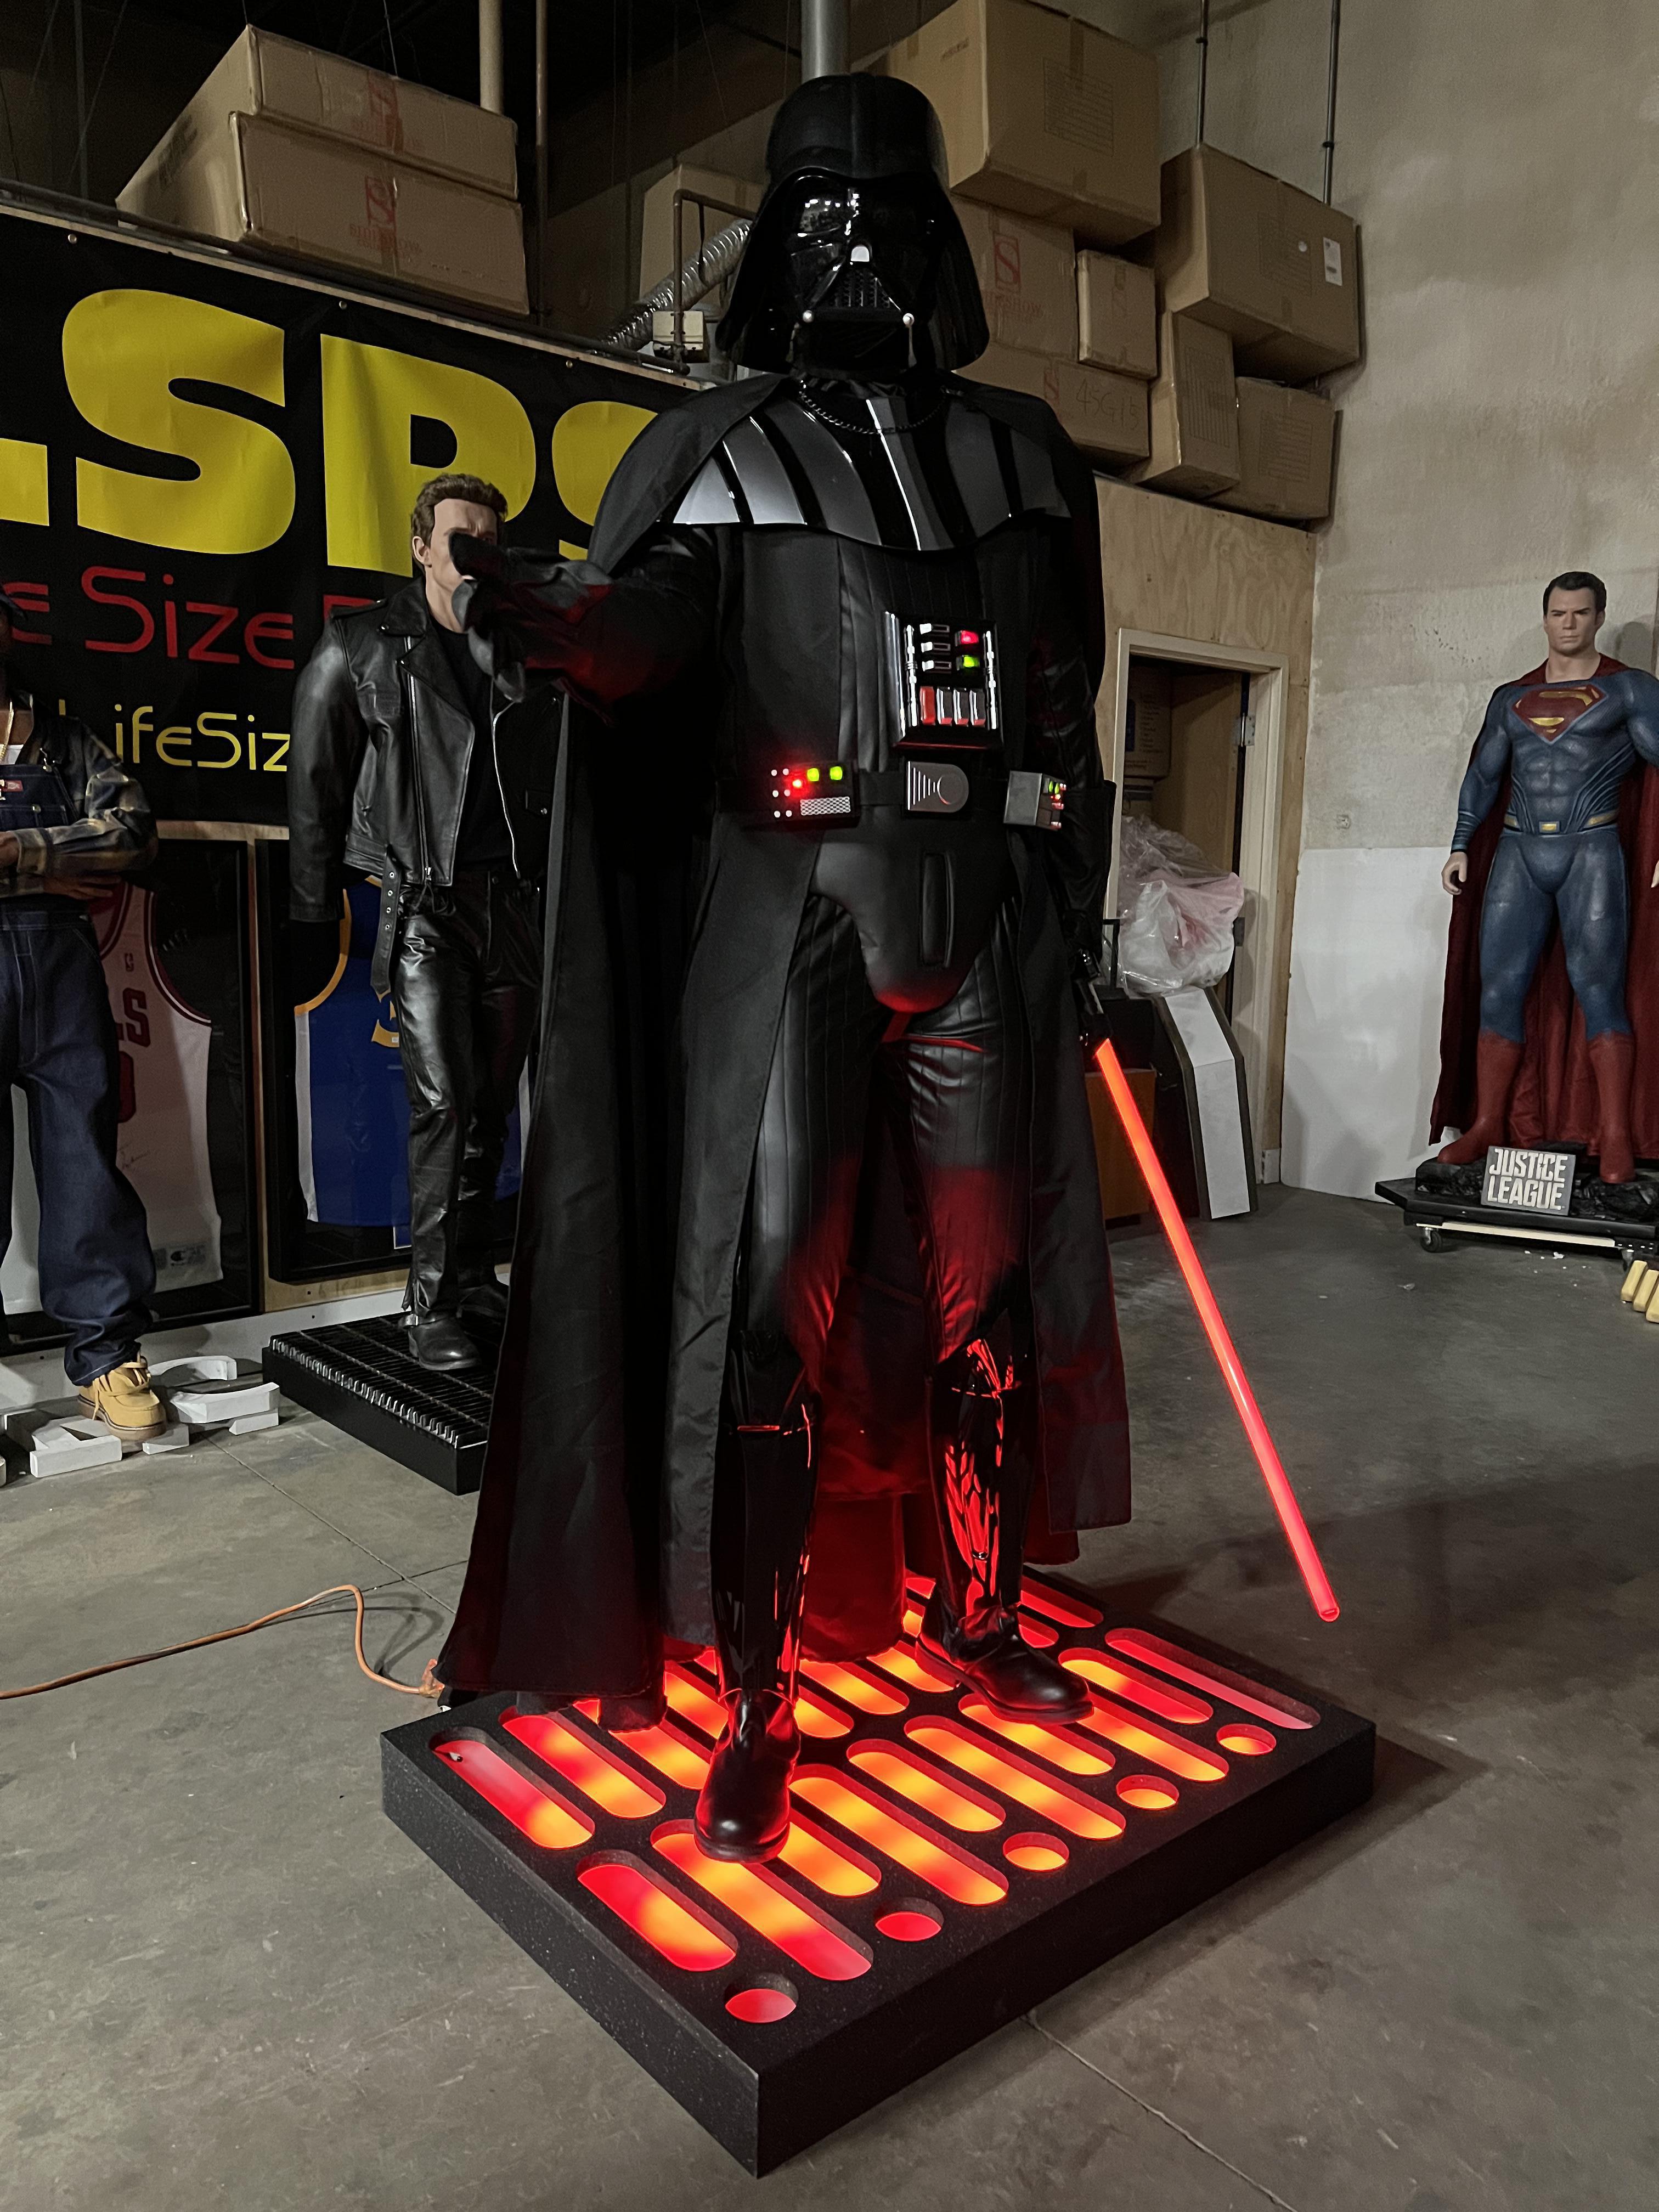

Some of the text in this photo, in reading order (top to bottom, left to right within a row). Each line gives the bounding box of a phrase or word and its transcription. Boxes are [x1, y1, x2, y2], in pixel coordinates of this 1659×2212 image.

[59, 698, 291, 772] ifeSiz
[1489, 1148, 1568, 1182] JUSTICE
[1487, 1175, 1565, 1210] LEAGUE
